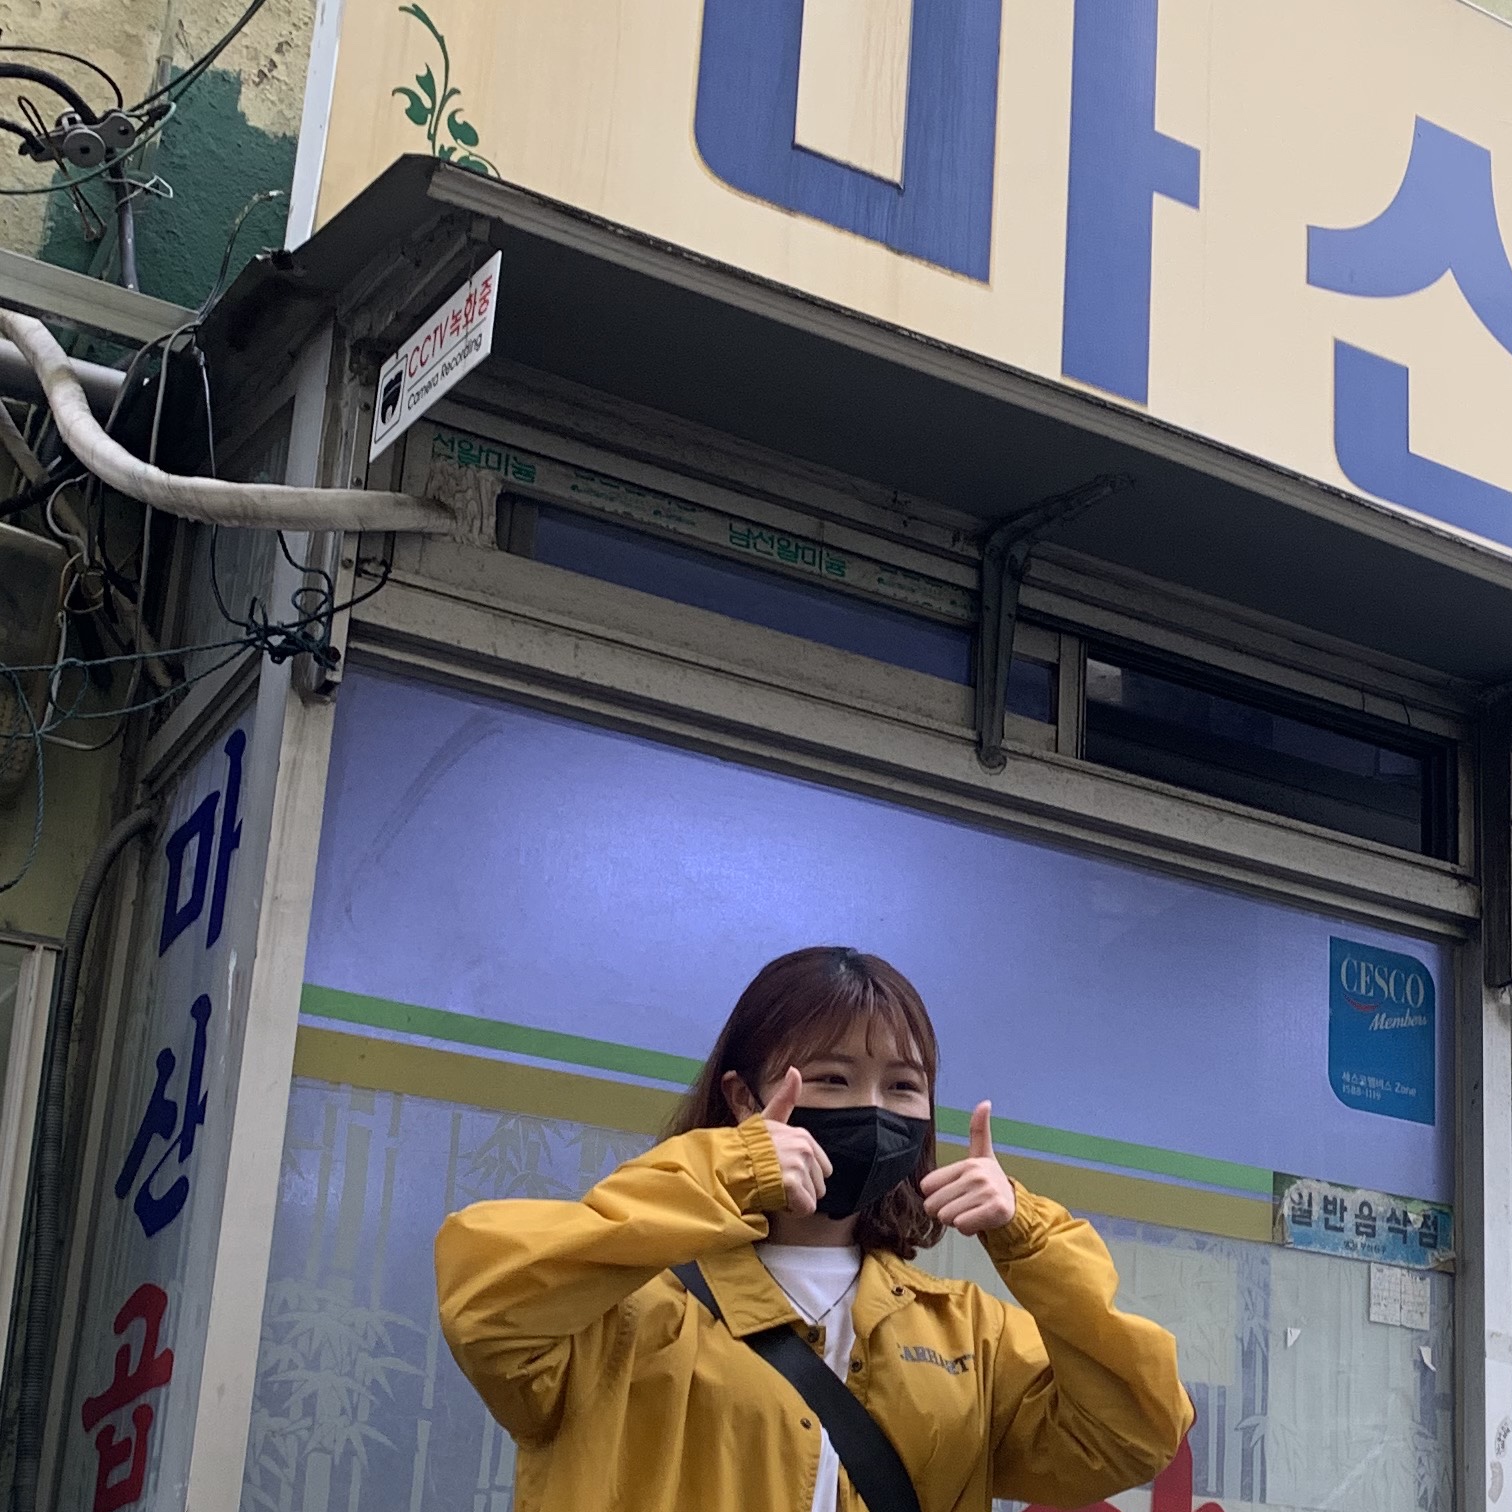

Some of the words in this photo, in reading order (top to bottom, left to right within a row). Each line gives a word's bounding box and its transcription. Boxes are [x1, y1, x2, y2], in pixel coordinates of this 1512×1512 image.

[407, 372, 438, 411] Camera
[440, 333, 482, 382] Recording
[1340, 957, 1425, 1009] CESCO
[1369, 1008, 1428, 1031] Members
[1394, 1082, 1417, 1097] Zone
